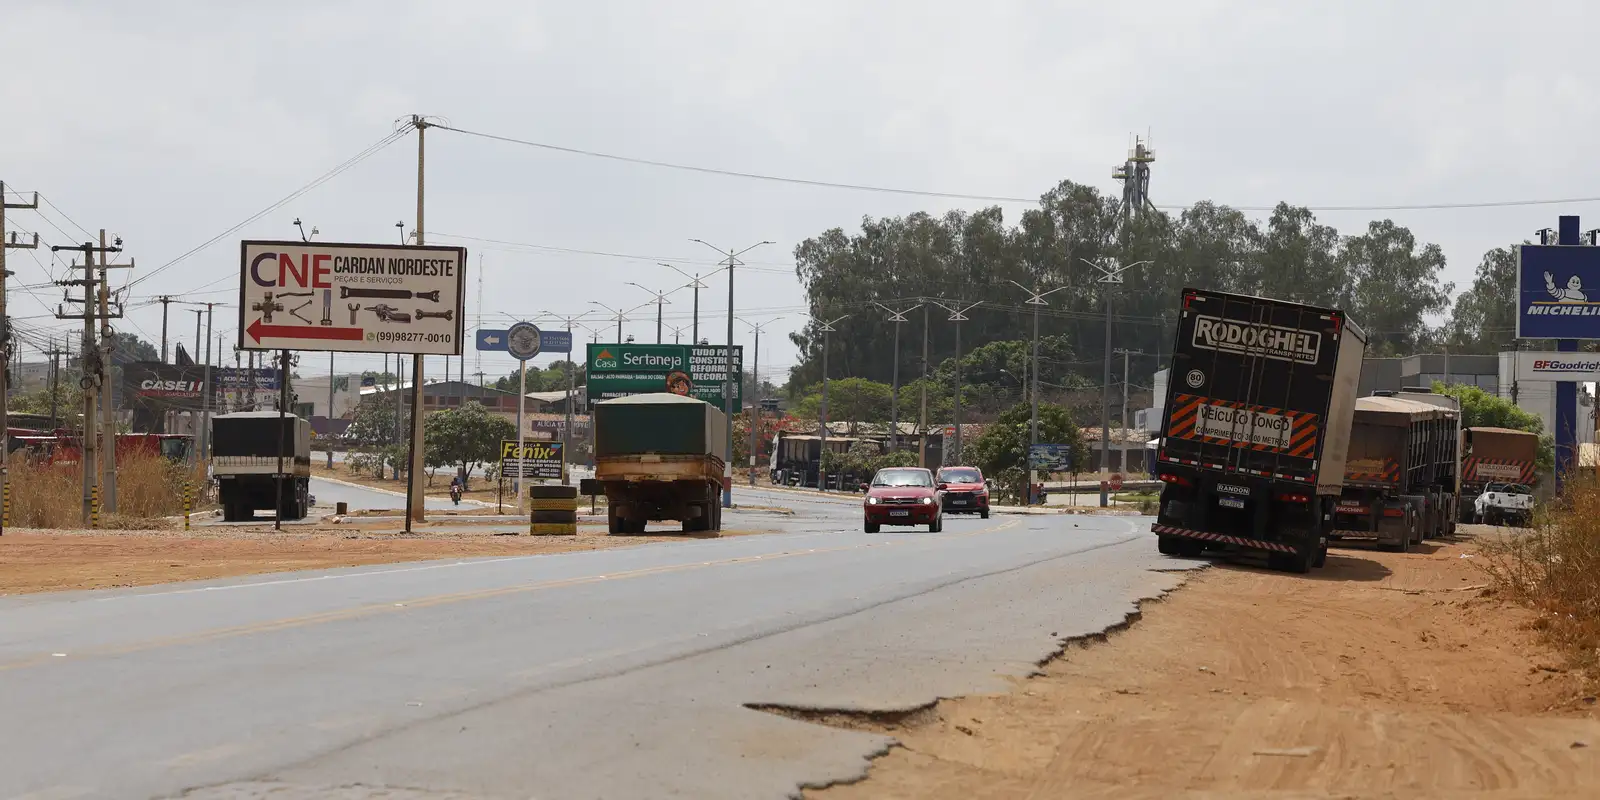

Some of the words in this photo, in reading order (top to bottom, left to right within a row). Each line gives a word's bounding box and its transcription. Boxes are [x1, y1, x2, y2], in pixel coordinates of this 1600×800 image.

[251, 252, 332, 289] CNE
[334, 256, 384, 275] CARDAN
[388, 258, 454, 277] NORDESTE
[334, 275, 359, 283] PEÇAS
[366, 276, 403, 284] SERVIÇOS
[376, 332, 451, 343] (99)98277-0010
[1197, 319, 1315, 354] RODOGHEL
[692, 348, 716, 356] TUDO
[717, 348, 740, 357] PAA
[1266, 348, 1315, 361] TRANSPORTES
[595, 359, 617, 368] Casa
[623, 352, 682, 369] Sertaneja
[689, 356, 742, 365] CONSTRR,
[1533, 360, 1600, 370] BFGoodrich
[690, 364, 739, 373] REFORMR,
[692, 373, 736, 381] DECORA.
[1190, 373, 1201, 381] 80
[141, 379, 184, 391] CASE
[1201, 408, 1248, 425] VEÍCULO
[1252, 414, 1290, 431] LONGO
[1262, 435, 1289, 447] METROS
[1218, 484, 1249, 495] RANDON
